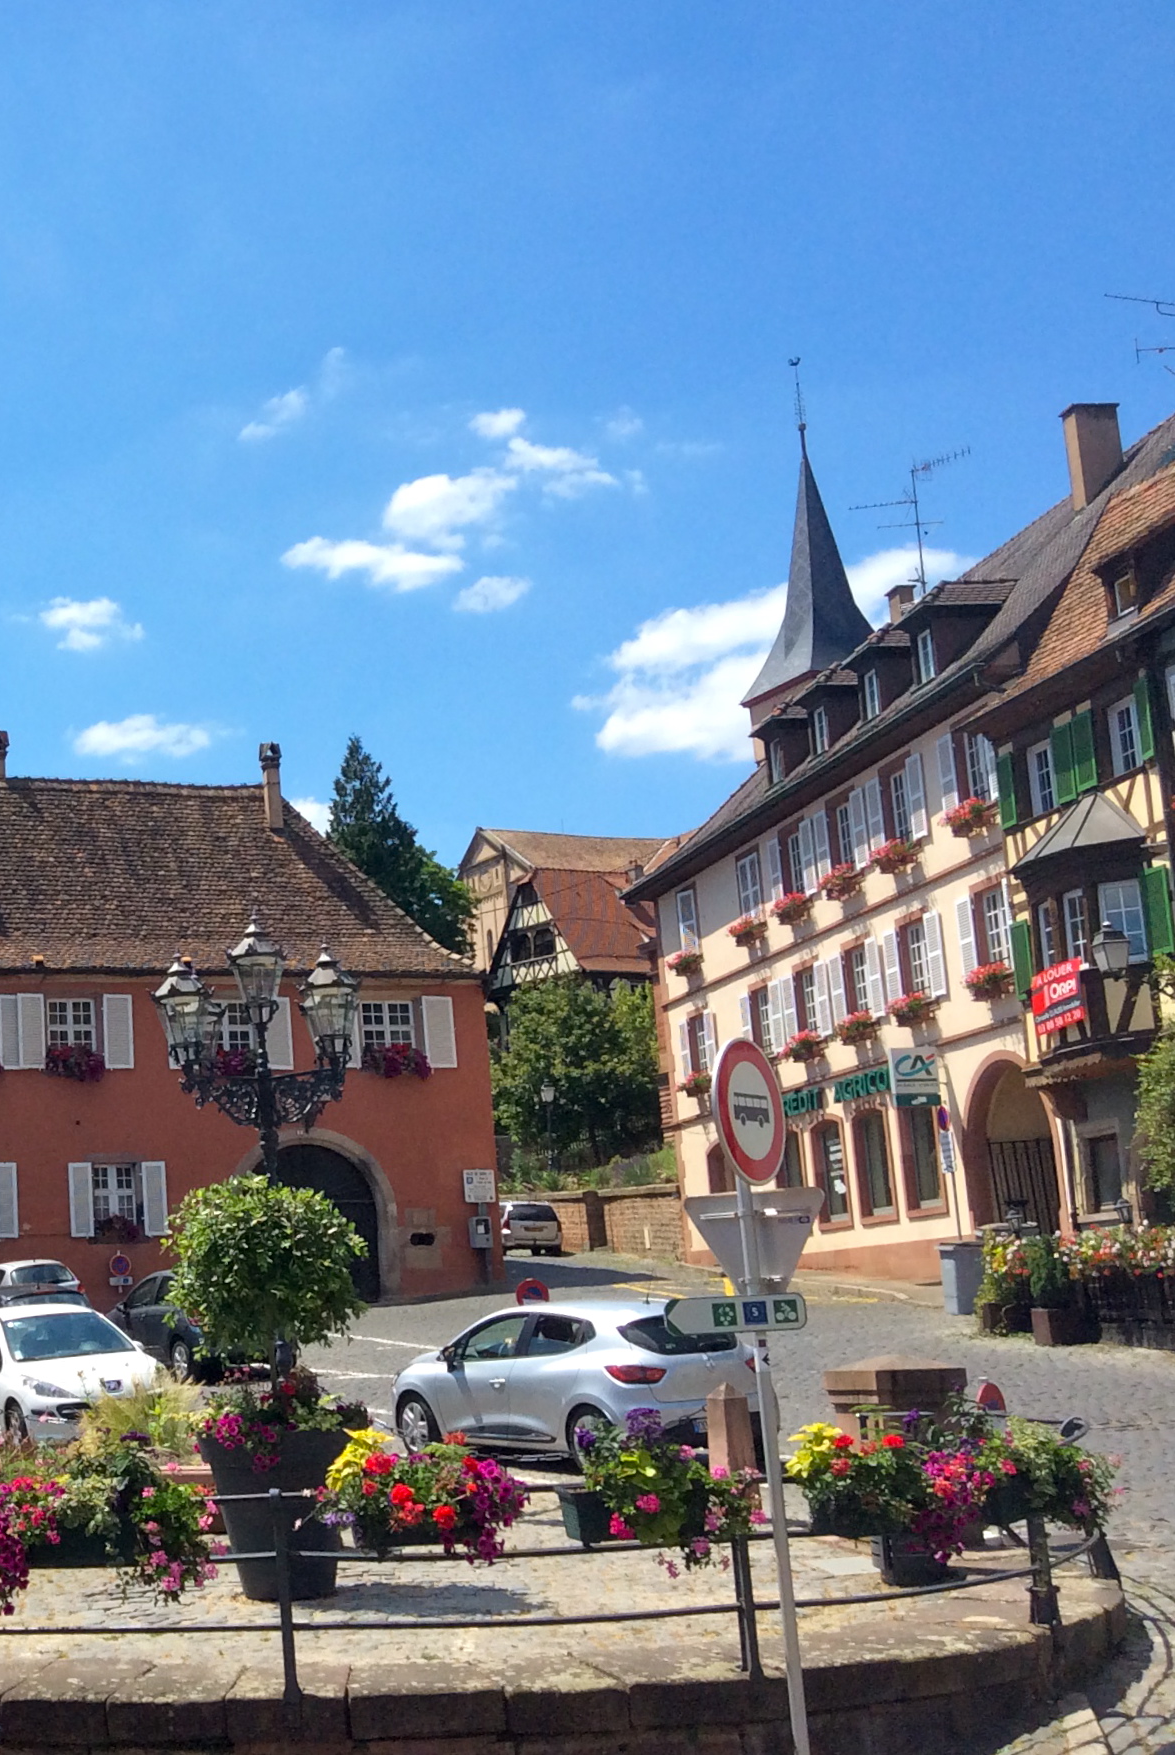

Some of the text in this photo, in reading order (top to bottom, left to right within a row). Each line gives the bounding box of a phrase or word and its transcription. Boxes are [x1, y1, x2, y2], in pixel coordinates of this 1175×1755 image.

[1043, 962, 1073, 982] LOUER
[1049, 977, 1077, 999] ORPI
[782, 1067, 891, 1117] RÉDIT AGRICO
